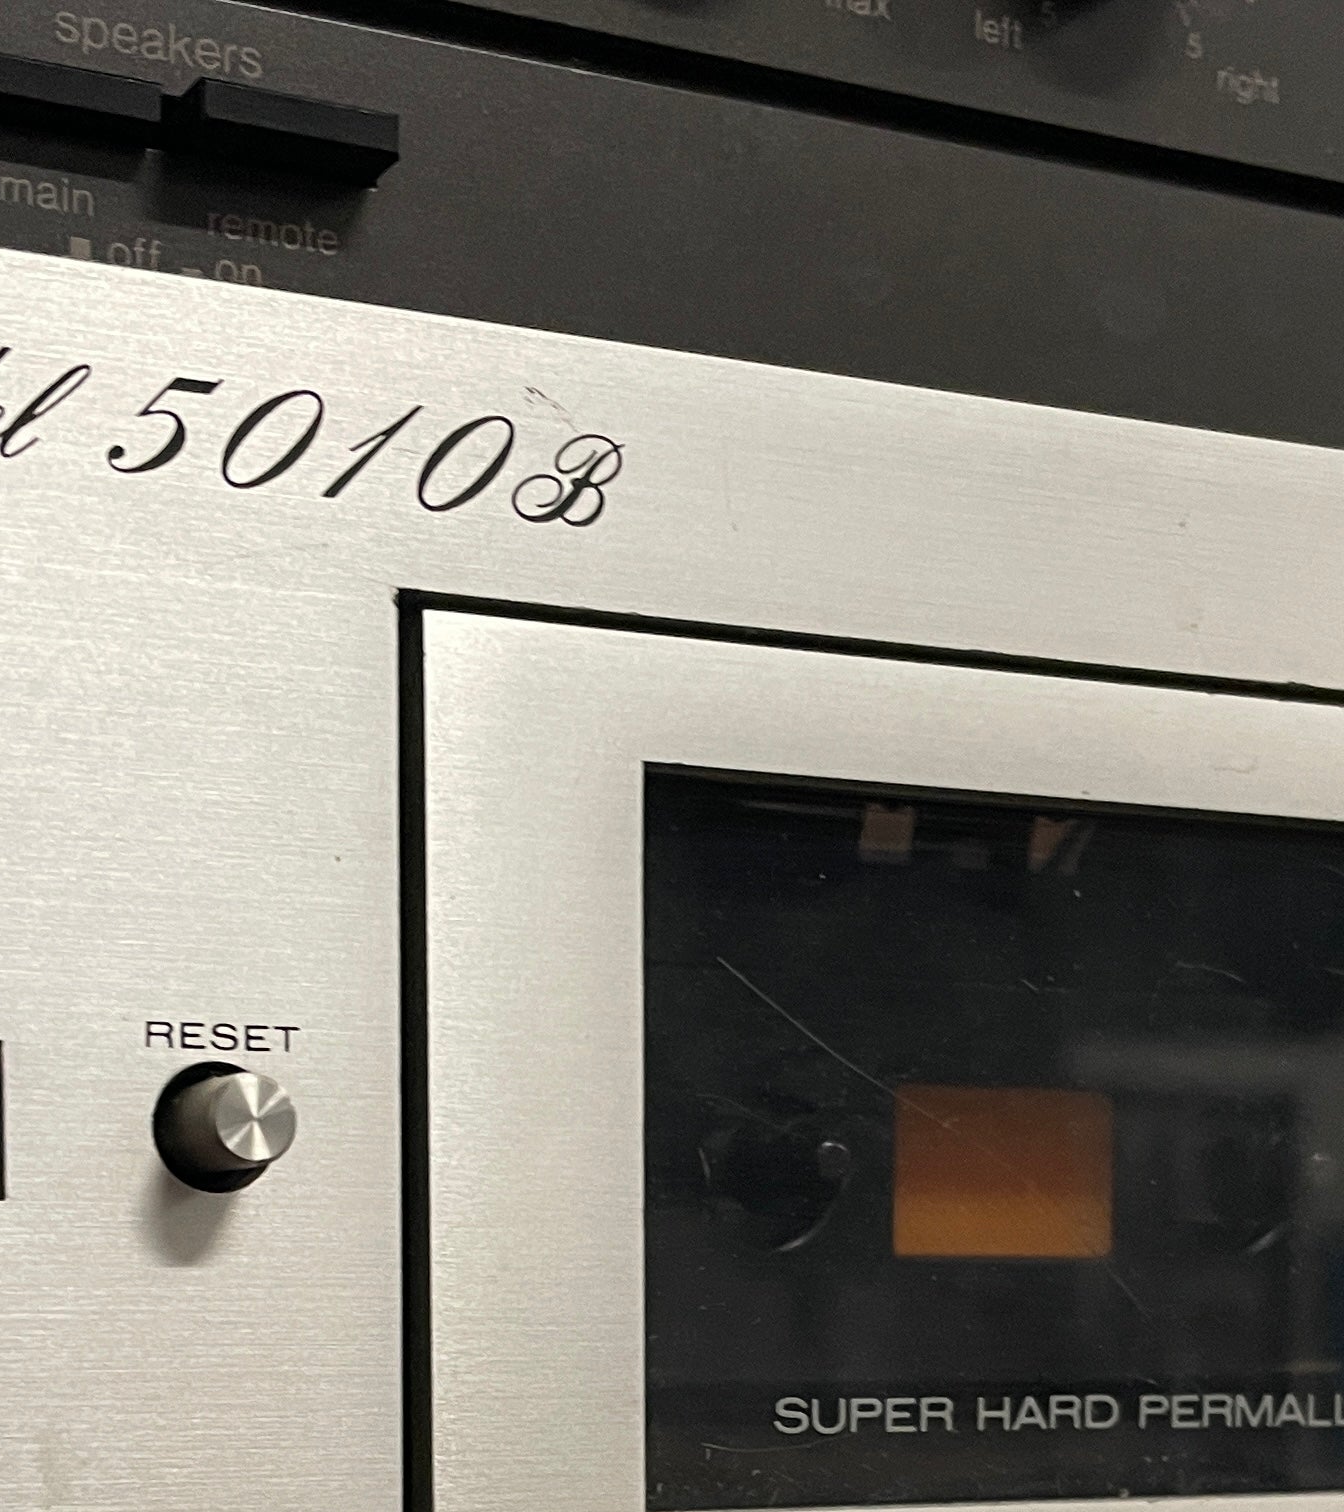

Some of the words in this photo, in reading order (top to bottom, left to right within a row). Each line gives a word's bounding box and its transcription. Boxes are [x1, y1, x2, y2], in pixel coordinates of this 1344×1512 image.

[53, 8, 264, 81] speakers
[975, 9, 1022, 50] left
[1216, 65, 1281, 105] right
[206, 210, 339, 256] remote
[107, 376, 624, 527] 5010B
[144, 1021, 302, 1053] RESET
[772, 1396, 955, 1435] SUPER
[975, 1395, 1121, 1433] HARD
